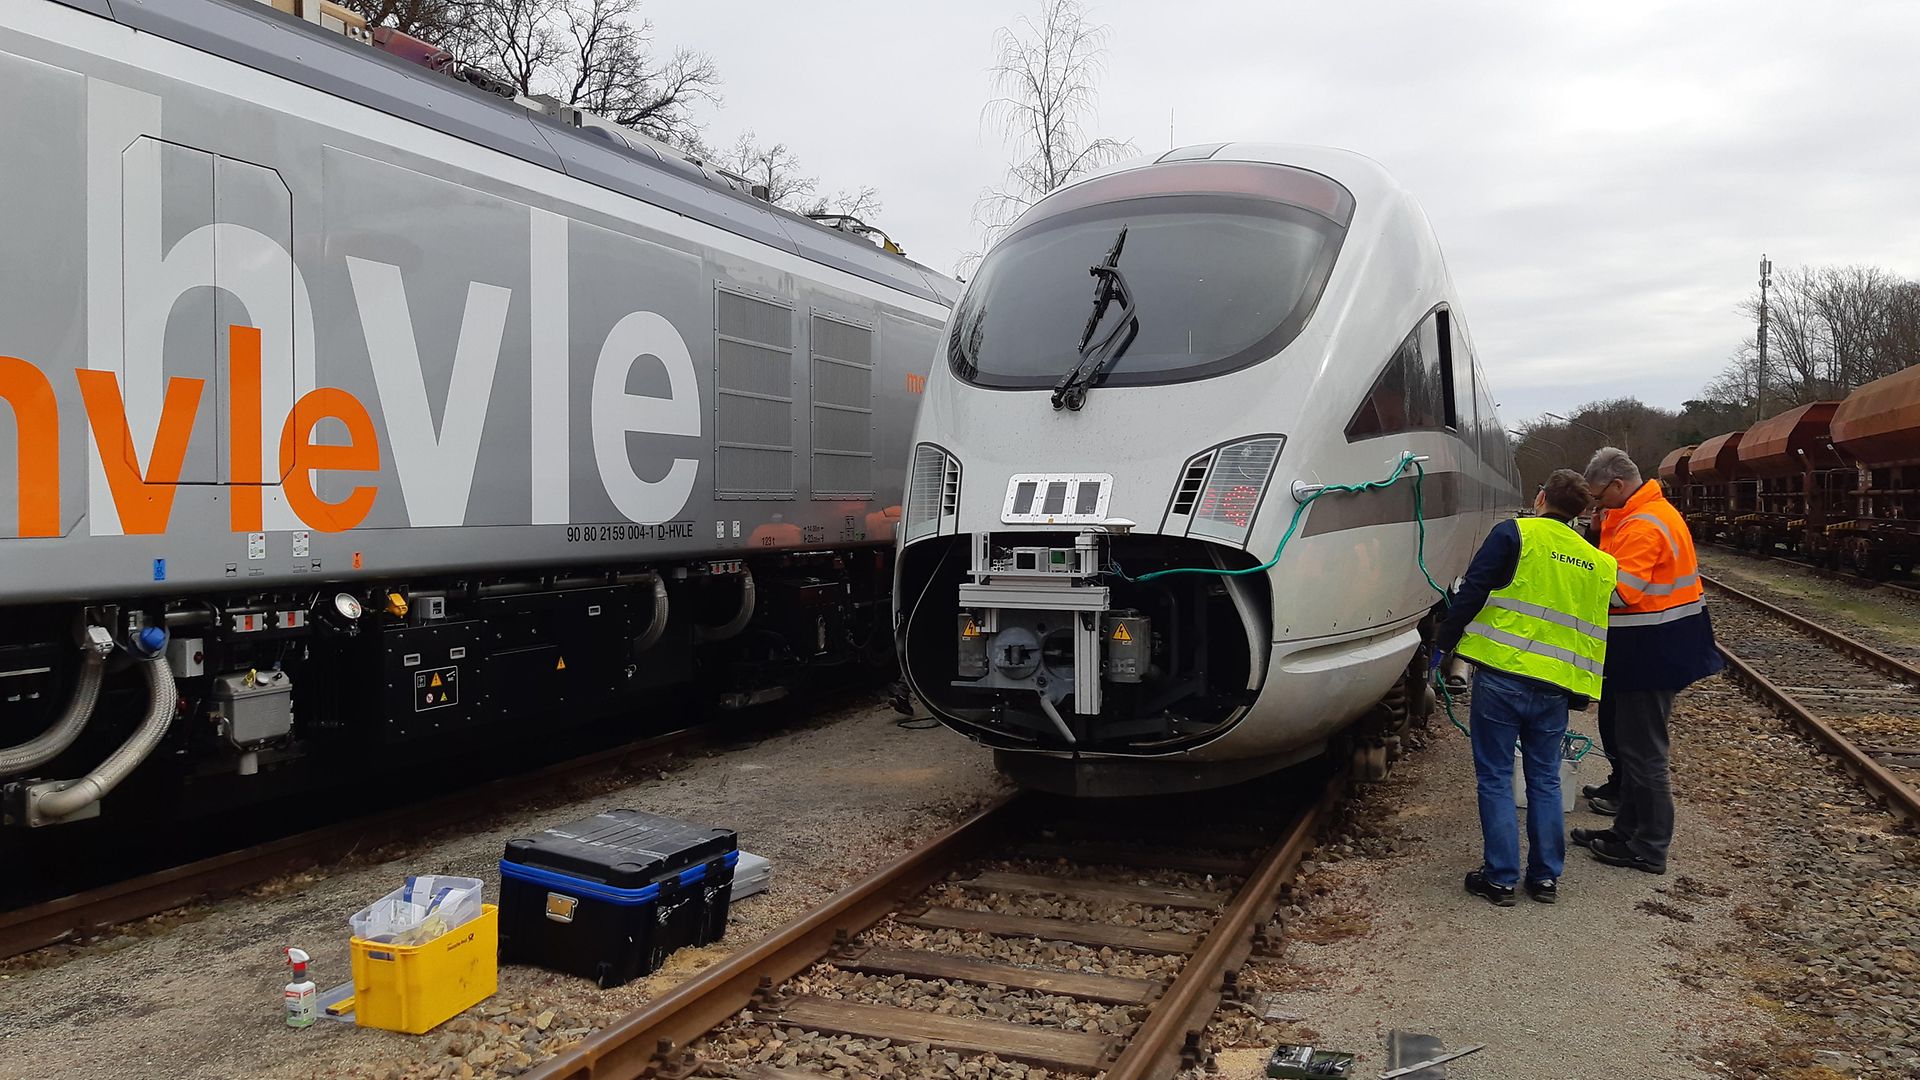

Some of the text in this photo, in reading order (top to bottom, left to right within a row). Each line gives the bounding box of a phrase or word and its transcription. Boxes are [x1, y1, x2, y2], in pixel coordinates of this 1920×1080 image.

[87, 76, 701, 537] hvle
[567, 523, 693, 542] 90 80 2159 004-1 D-HVLE
[1551, 551, 1594, 571] SIEMENS
